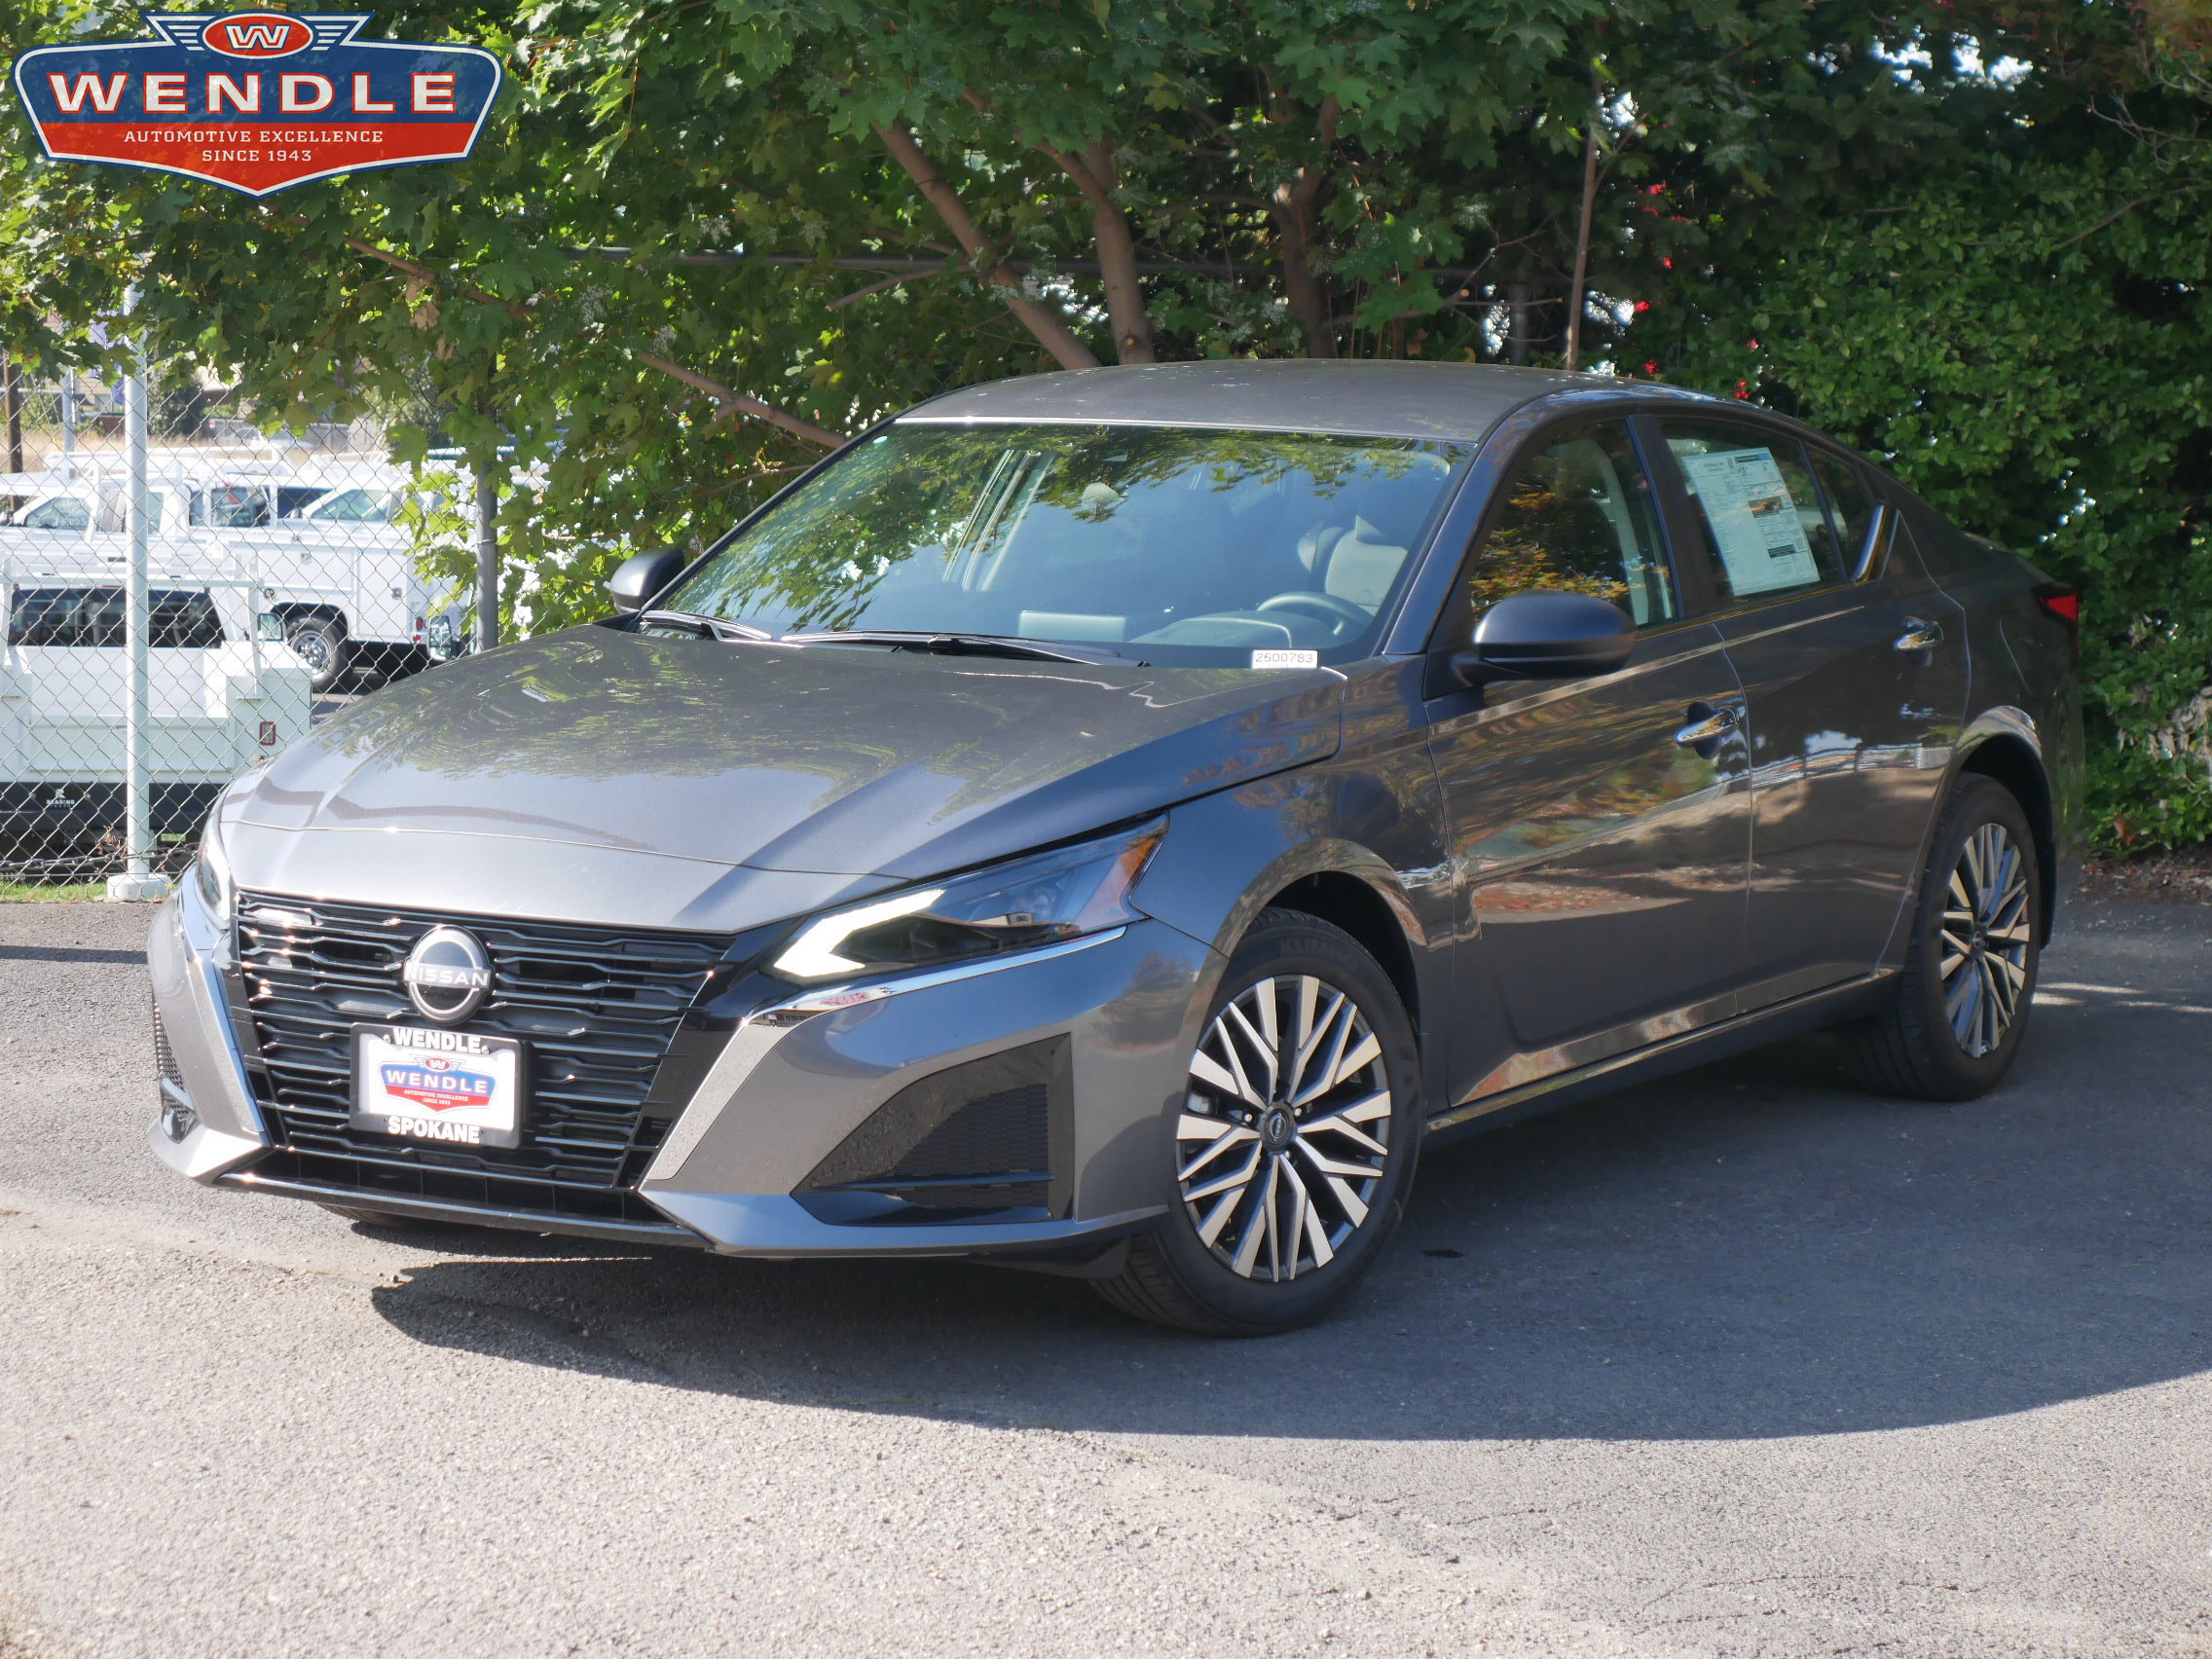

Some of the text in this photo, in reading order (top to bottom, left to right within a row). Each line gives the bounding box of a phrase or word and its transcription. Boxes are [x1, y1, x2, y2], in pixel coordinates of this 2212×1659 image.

[1255, 652, 1313, 663] 2500783
[1278, 938, 1358, 972] KUMHO
[404, 965, 489, 987] NISSAN
[392, 1027, 482, 1054] WENDLE
[386, 1069, 488, 1094] WENDLE
[387, 1116, 481, 1144] SPOKANE
